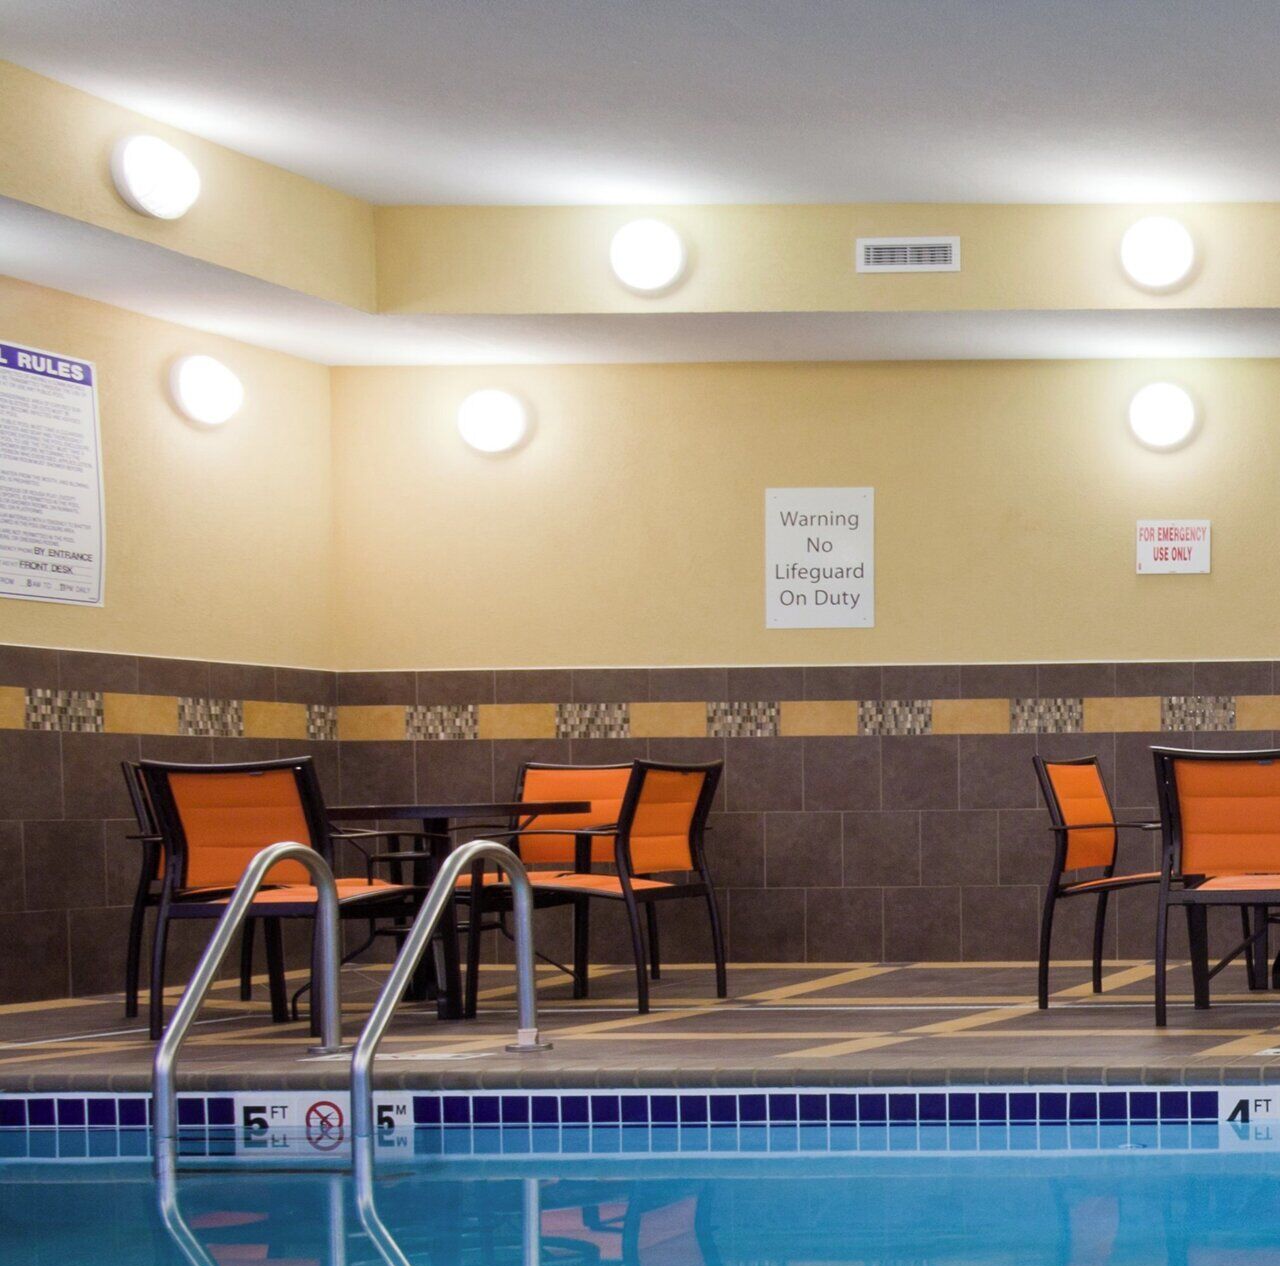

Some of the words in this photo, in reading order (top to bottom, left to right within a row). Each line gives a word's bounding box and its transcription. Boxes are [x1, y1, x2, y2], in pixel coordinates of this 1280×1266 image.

[17, 352, 84, 381] RULES
[780, 511, 859, 530] Warning
[1139, 527, 1155, 541] FOR
[1158, 527, 1207, 541] EMERGENCY
[807, 537, 833, 552] No
[34, 546, 45, 555] BY
[48, 548, 93, 562] ENTRANCE
[1153, 547, 1169, 561] USE
[1171, 546, 1192, 561] ONLY
[19, 560, 48, 572] FRONT
[51, 563, 74, 575] DESK
[775, 562, 864, 583] Lifeguard
[780, 590, 807, 606] On
[815, 589, 860, 609] Duty
[243, 1106, 269, 1129] 5
[270, 1106, 288, 1119] FT
[396, 1104, 406, 1115] M
[1226, 1099, 1250, 1123] 4
[1254, 1099, 1272, 1112] FT
